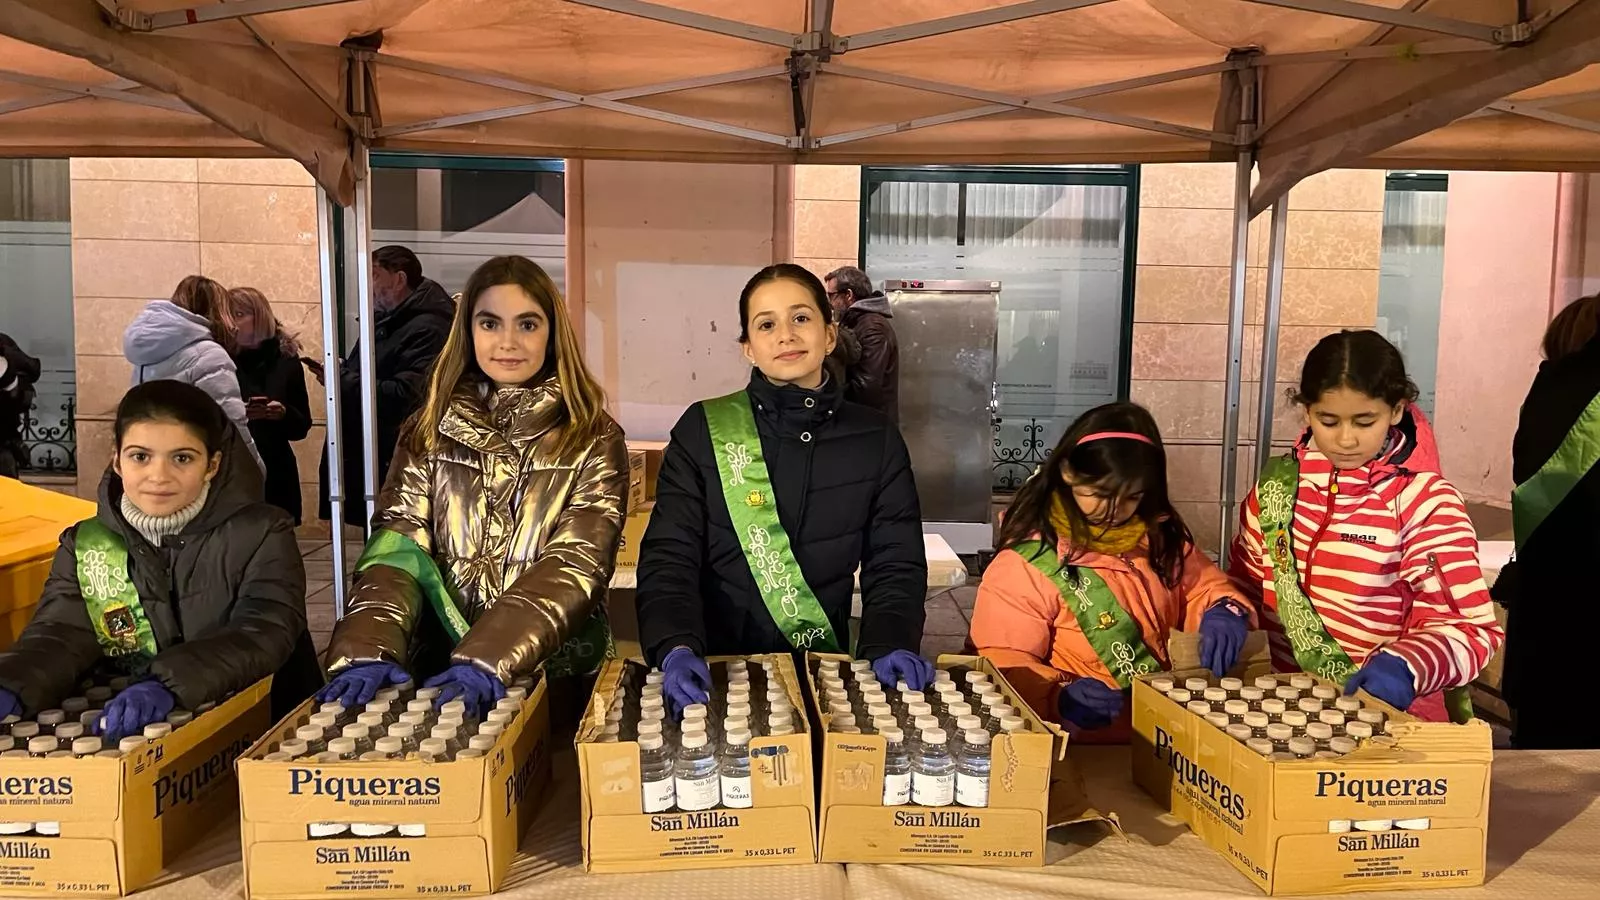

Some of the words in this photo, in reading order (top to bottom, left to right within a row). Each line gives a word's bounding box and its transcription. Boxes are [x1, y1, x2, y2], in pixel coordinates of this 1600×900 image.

[152, 732, 250, 820] Piqueras
[1155, 725, 1245, 821] Piqueras
[288, 768, 441, 802] Piqueras
[1314, 771, 1448, 803] Piqueras
[42, 796, 74, 806] natural
[349, 799, 371, 808] agua
[372, 797, 406, 806] mineral
[407, 796, 441, 806] natural
[1367, 800, 1387, 808] agua
[1387, 798, 1418, 807] mineral
[1418, 797, 1447, 806] natural
[650, 814, 683, 832] San
[687, 812, 739, 830] Millán
[894, 810, 925, 827] San
[929, 811, 981, 828] Millán
[0, 842, 51, 859] Millán
[1337, 835, 1368, 852] San
[1371, 833, 1420, 850] Millán
[316, 847, 350, 865] San
[354, 846, 410, 863] Millán
[744, 848, 754, 857] 35
[760, 848, 775, 857] 0,33
[782, 847, 796, 856] PET
[983, 850, 992, 858] 35
[1020, 851, 1034, 859] PET
[1456, 869, 1469, 877] PET
[96, 884, 110, 892] PET
[457, 883, 472, 892] PET
